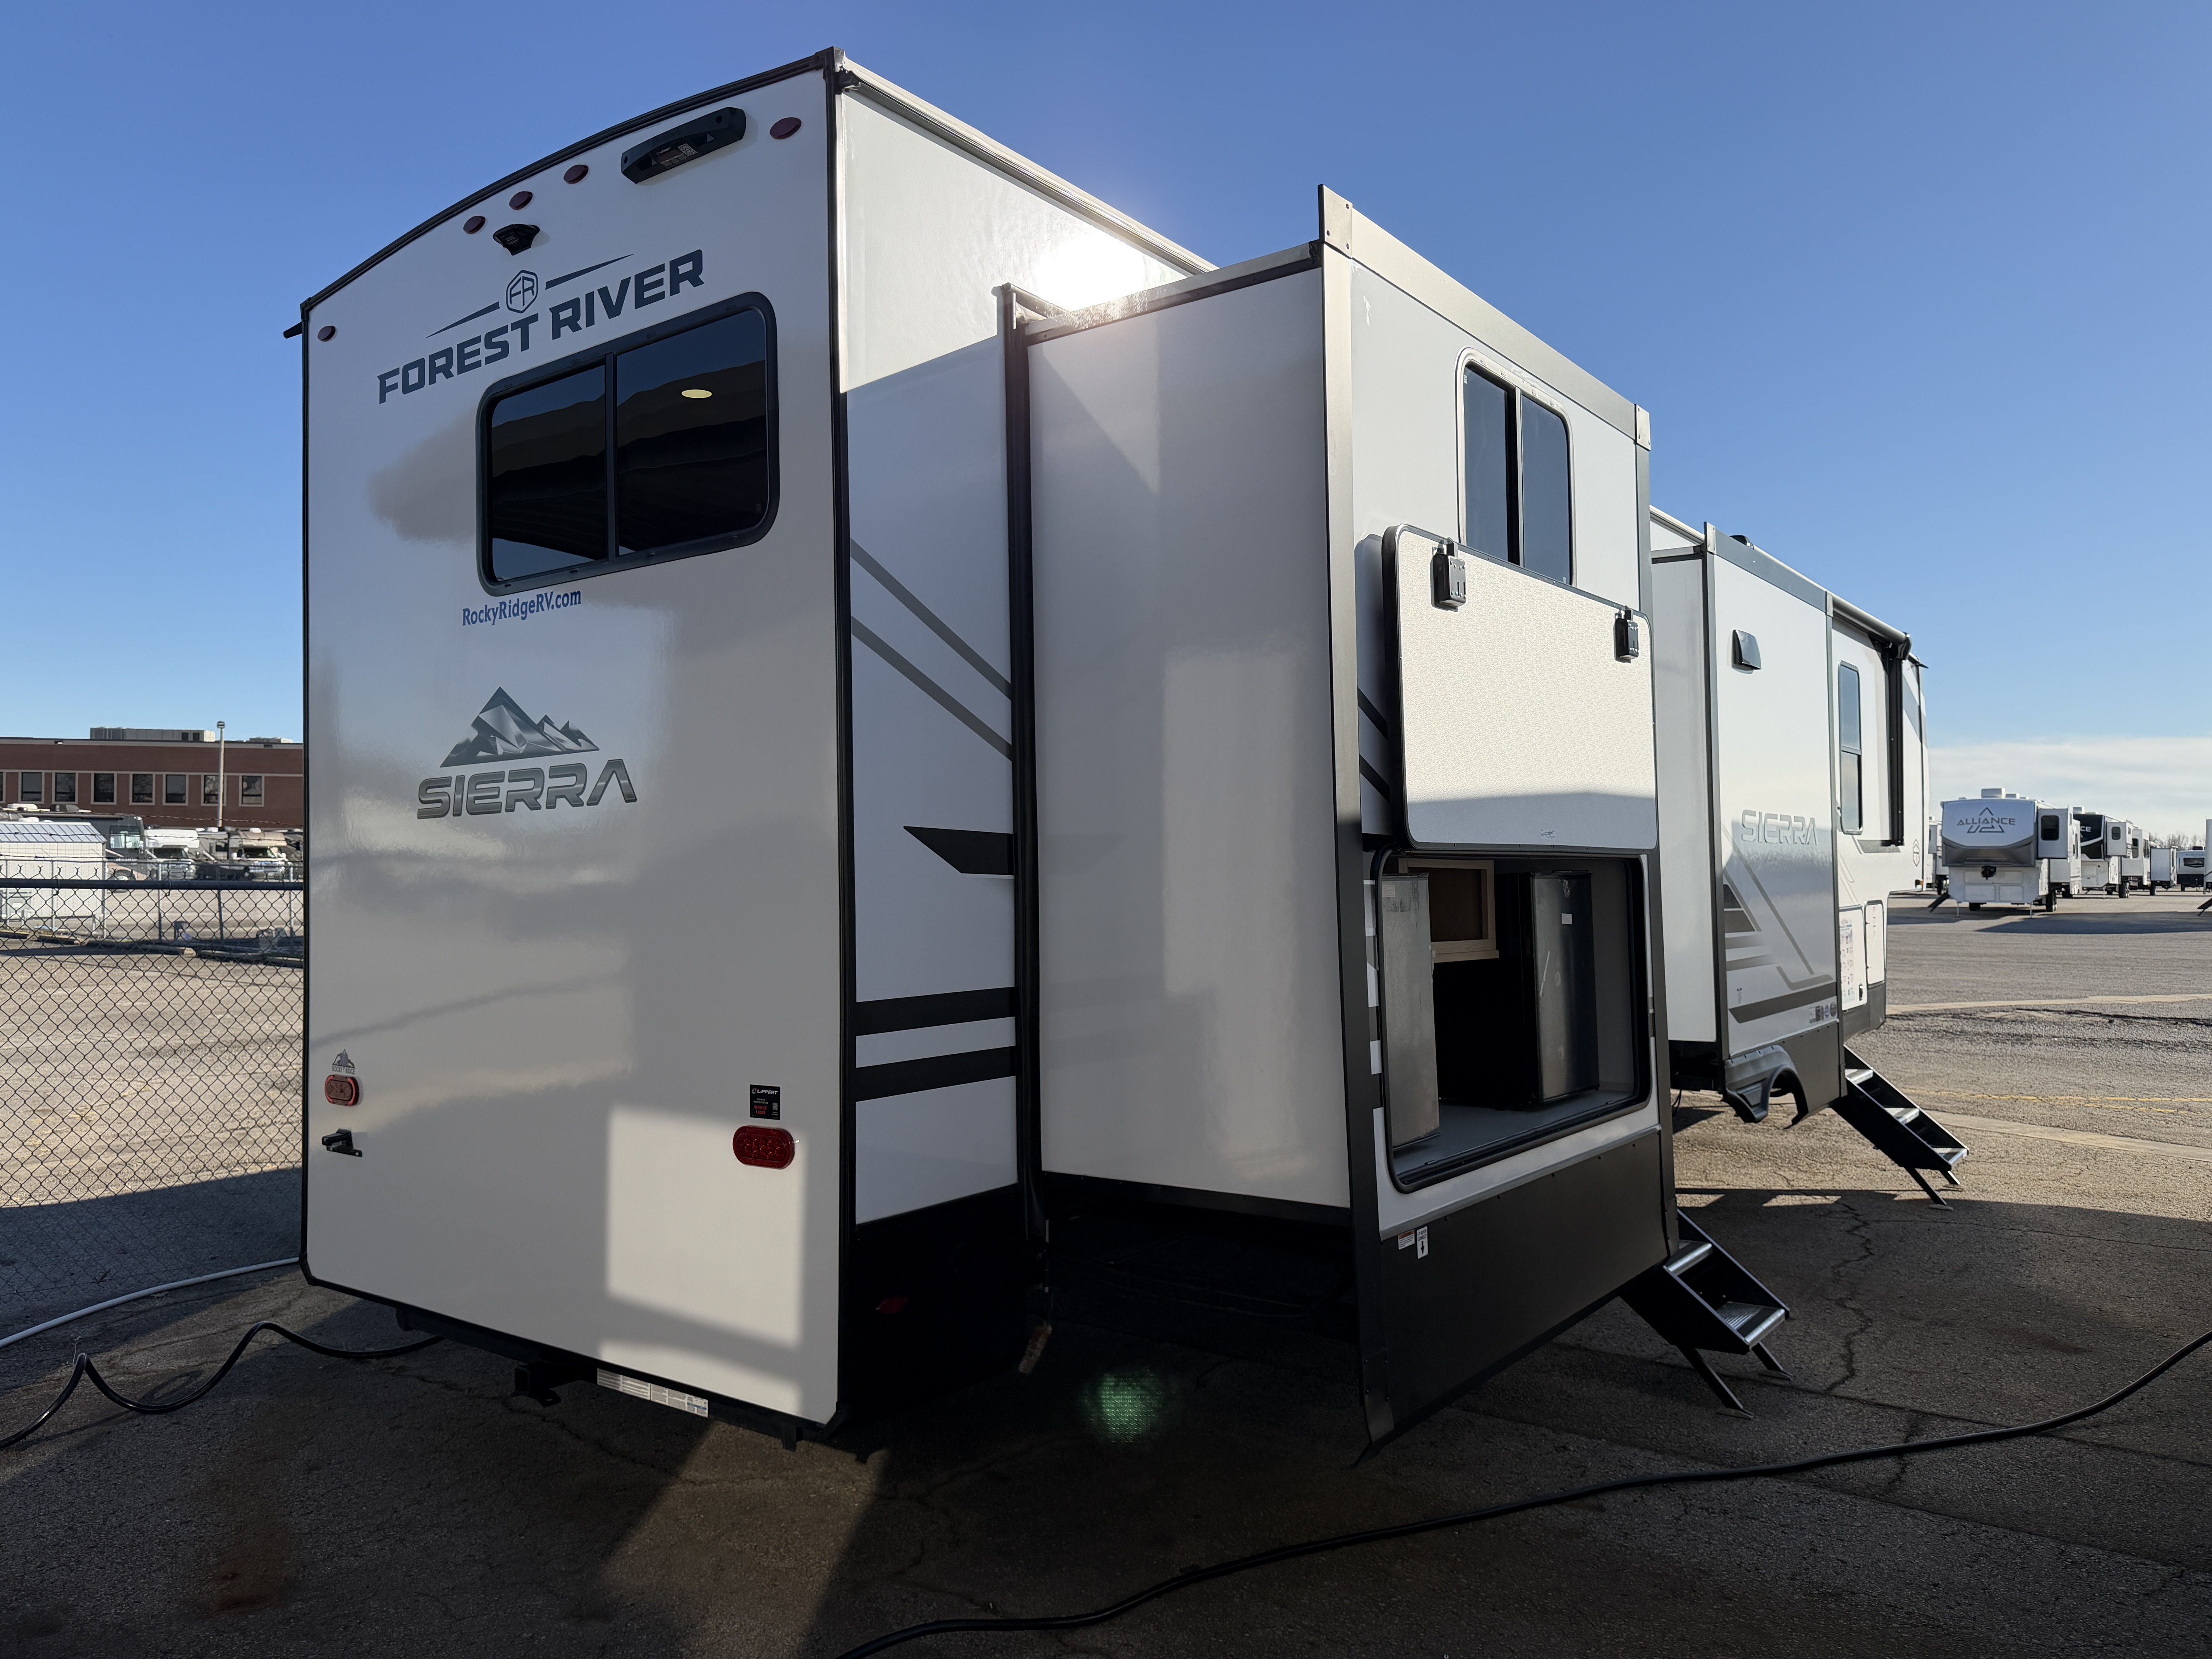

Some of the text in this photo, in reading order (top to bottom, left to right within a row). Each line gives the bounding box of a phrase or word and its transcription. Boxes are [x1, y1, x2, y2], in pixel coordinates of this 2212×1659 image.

[377, 249, 705, 404] FOREST RIVER
[462, 589, 582, 626] RockyRidgeRV.com
[417, 759, 637, 819] SIERRA
[1741, 809, 1819, 846] SIERRA
[1957, 817, 2016, 826] ALLIANCE
